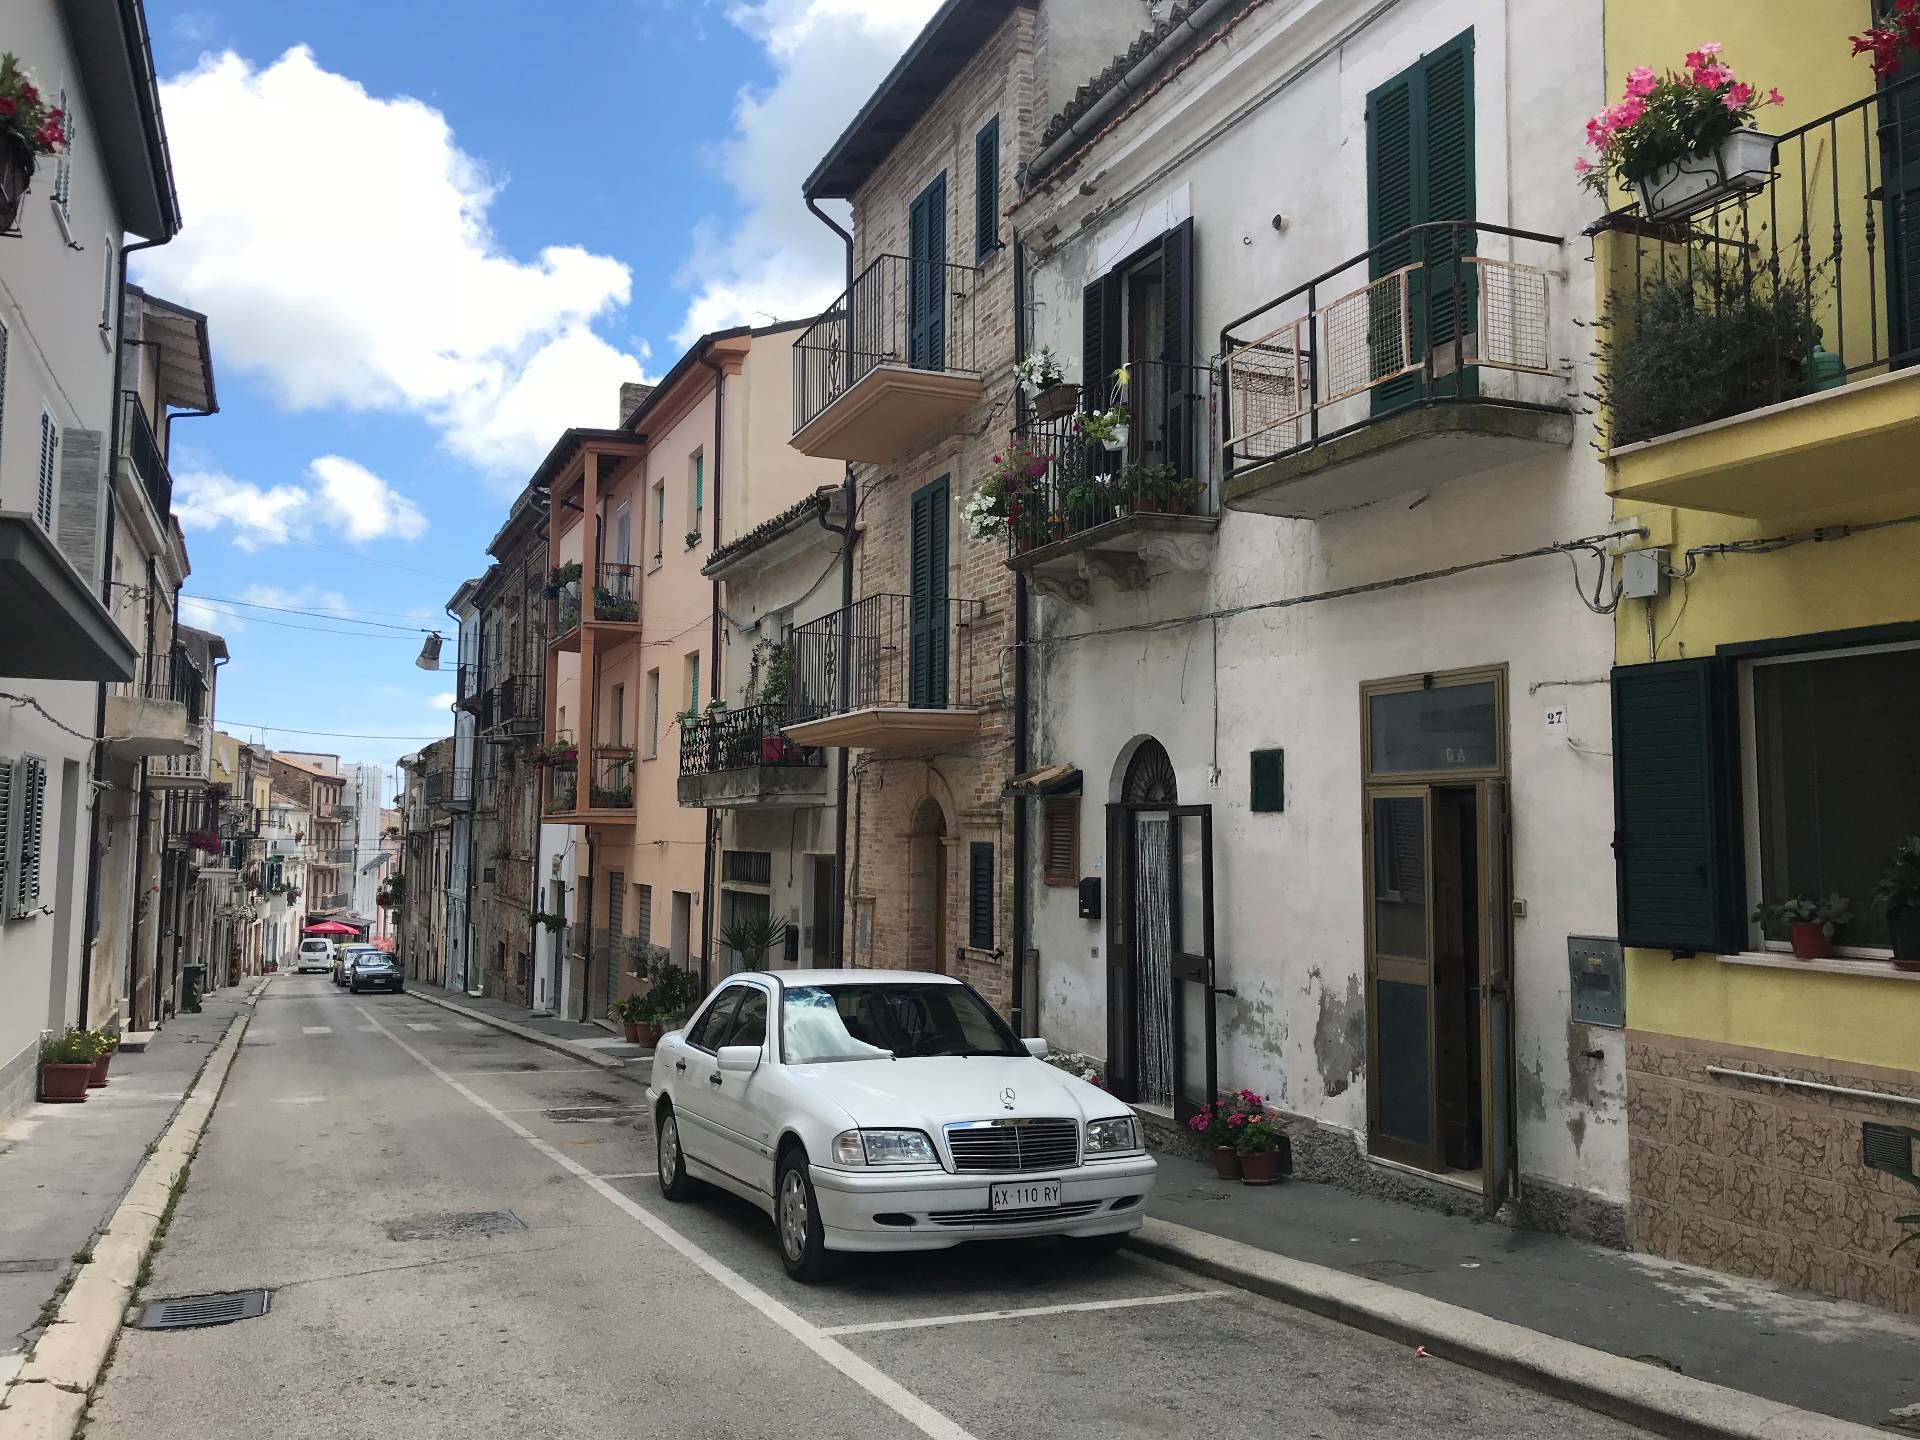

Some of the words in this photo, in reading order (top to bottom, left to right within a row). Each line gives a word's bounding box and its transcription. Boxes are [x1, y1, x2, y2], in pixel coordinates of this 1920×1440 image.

[1547, 711, 1562, 724] 27
[994, 1190, 1008, 1205] AX
[1017, 1187, 1038, 1203] 110
[1044, 1186, 1058, 1201] RY
